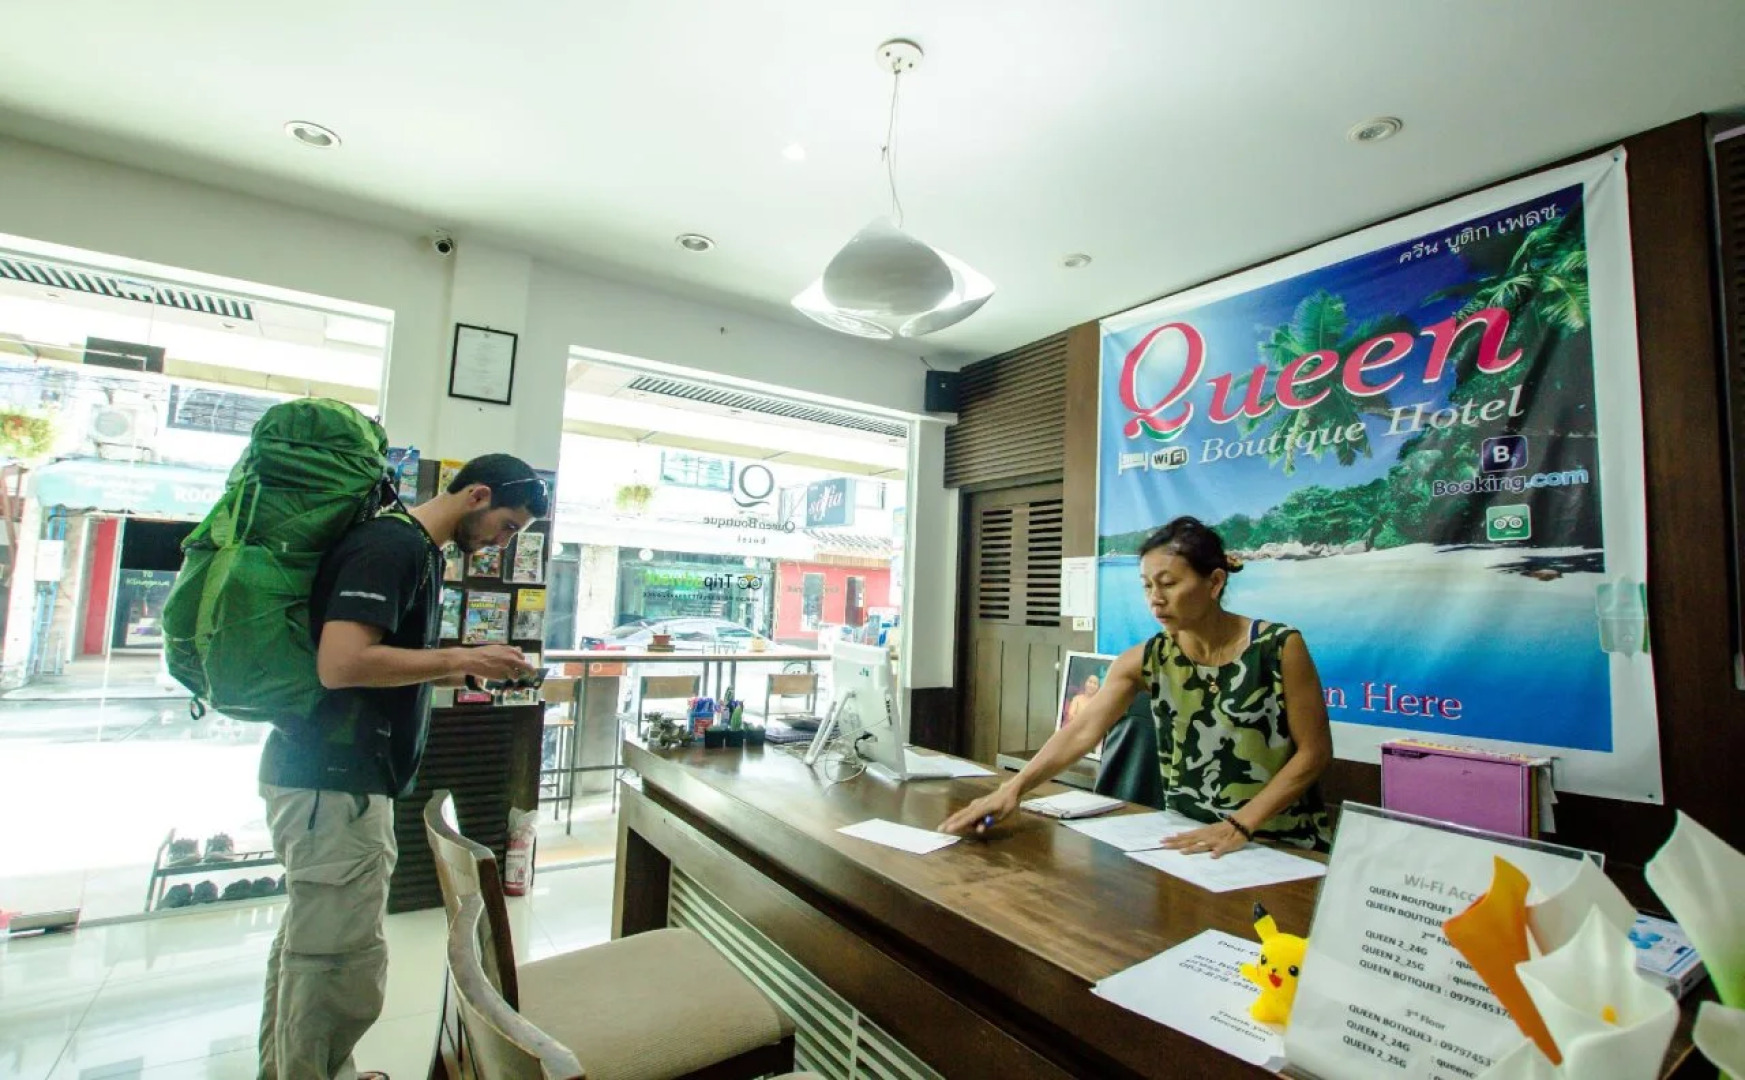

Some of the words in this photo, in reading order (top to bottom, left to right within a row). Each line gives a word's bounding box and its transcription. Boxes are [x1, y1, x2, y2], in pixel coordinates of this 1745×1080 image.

[1118, 307, 1523, 442] Queen
[1201, 418, 1367, 465] Boutique
[1385, 386, 1526, 437] Hotel
[1432, 469, 1589, 497] Booking.com
[1361, 681, 1463, 720] Here
[1369, 885, 1400, 900] QUEEN
[1404, 874, 1445, 894] Wi-Fi
[1449, 886, 1477, 902] Acc
[1365, 900, 1396, 914] QUEEN
[1398, 908, 1443, 928] BOUTQUE
[1365, 929, 1396, 946] QUEEN
[1398, 940, 1428, 956] 2_24G
[1361, 944, 1393, 961] QUEEN
[1452, 975, 1492, 994] queenc
[1358, 959, 1391, 976] QUEEN
[1392, 971, 1442, 994] BOTIQUE3
[1450, 990, 1514, 1019] 097974537
[1349, 1004, 1381, 1023] QUEEN
[1440, 1041, 1497, 1067] 09797453
[1420, 1014, 1447, 1031] Floor
[1342, 1035, 1375, 1054] QUEEN
[1346, 1019, 1378, 1039] QUEEN
[1436, 1057, 1479, 1080] queenc
